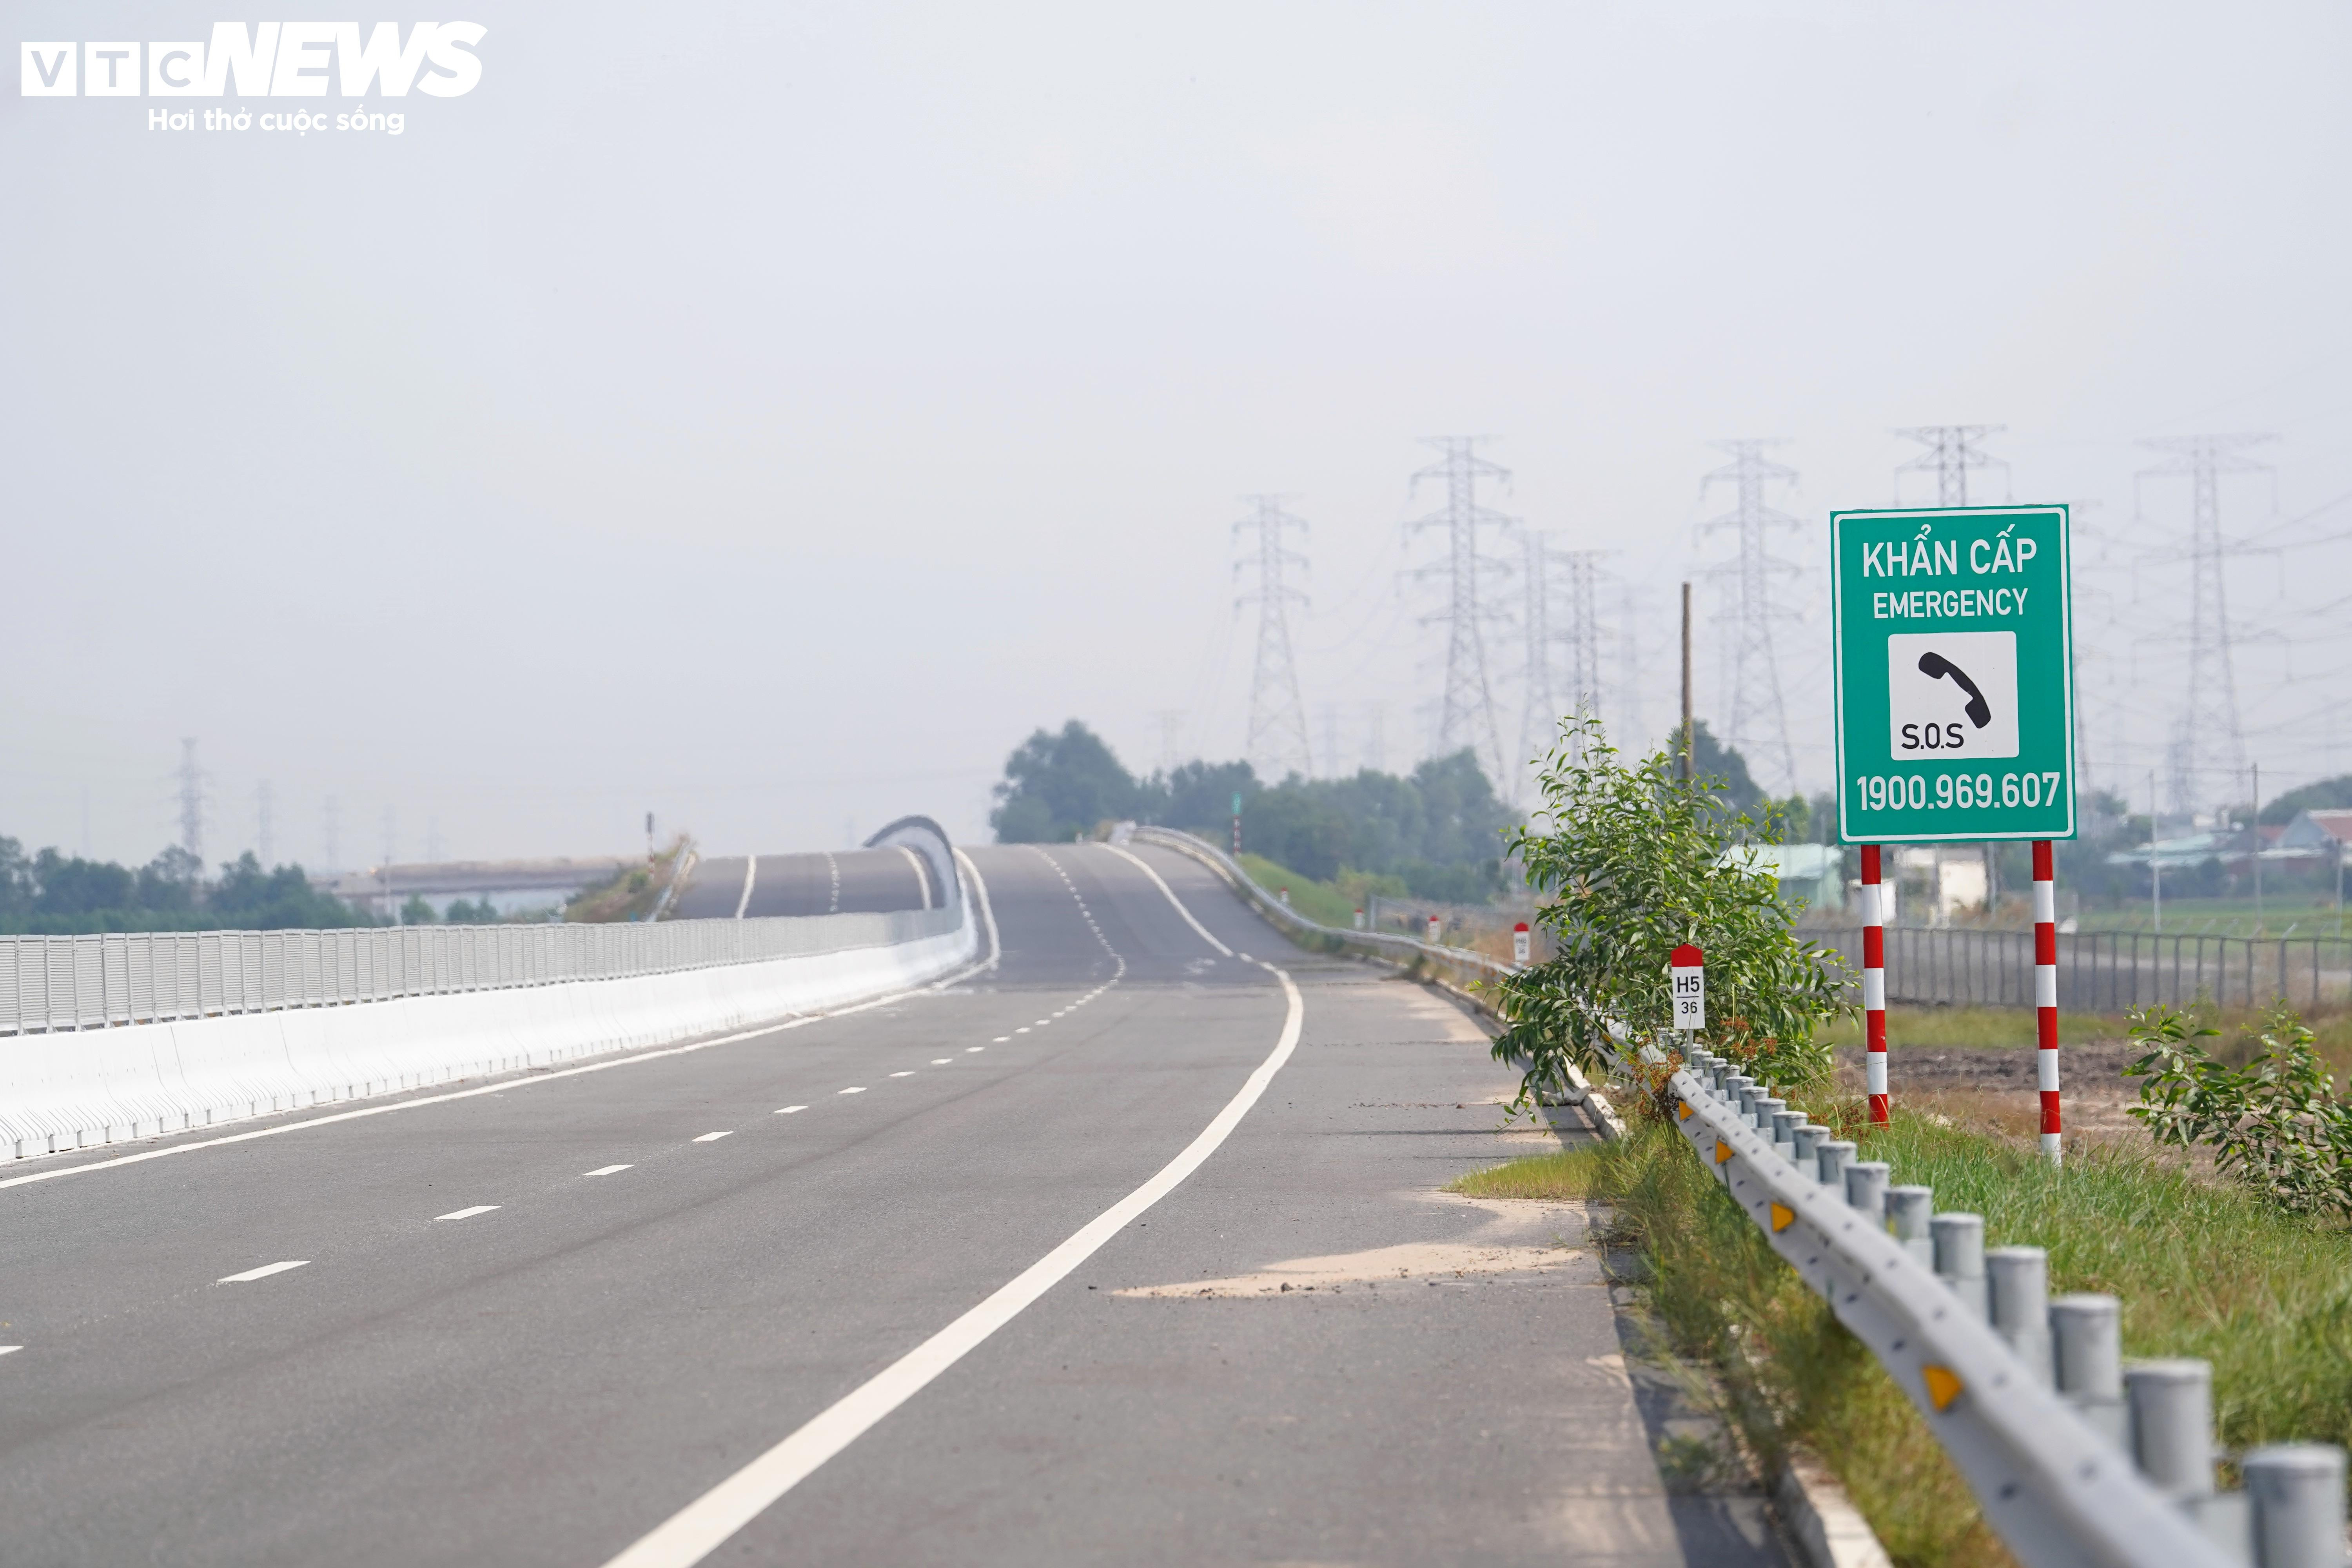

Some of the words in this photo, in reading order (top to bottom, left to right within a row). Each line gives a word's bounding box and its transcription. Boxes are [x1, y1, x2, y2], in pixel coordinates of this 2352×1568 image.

[1863, 524, 1957, 577] KHẨN
[1970, 524, 2037, 574] CẤP
[1874, 588, 2028, 619] EMERGENCY
[1901, 722, 1964, 750] S.O.S
[1857, 772, 2060, 811] 1900.969.607
[1677, 976, 1700, 993] H5
[1681, 1001, 1697, 1014] 36
